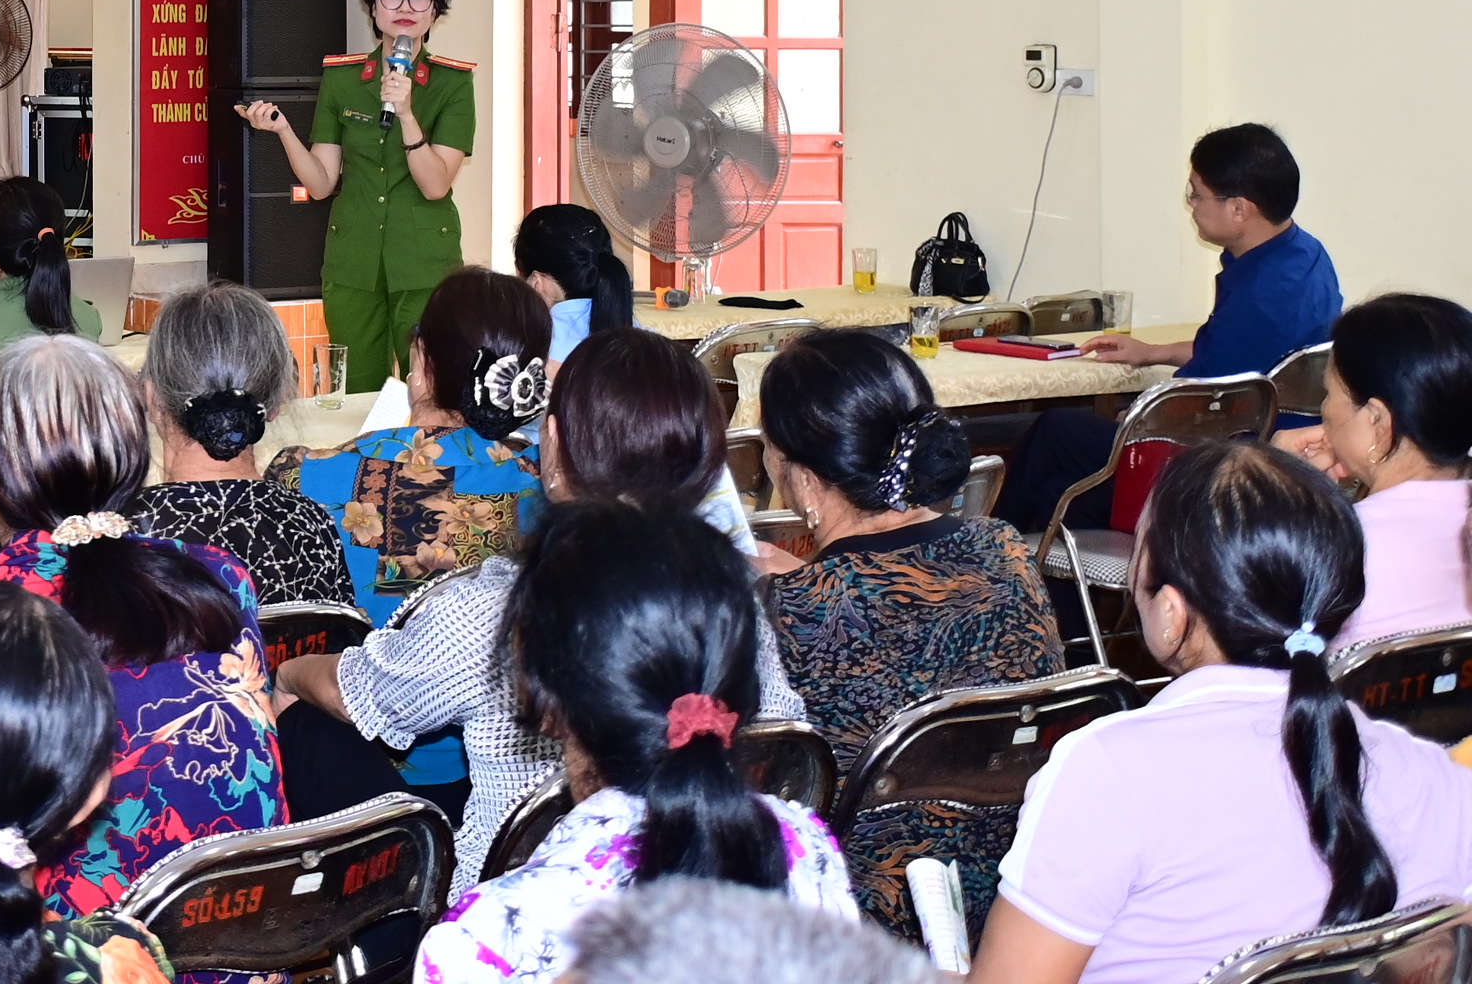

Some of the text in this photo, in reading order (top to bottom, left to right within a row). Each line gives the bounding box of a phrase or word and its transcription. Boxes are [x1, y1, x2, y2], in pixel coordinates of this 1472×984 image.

[152, 0, 187, 24] XỨNG
[152, 33, 186, 57] LÃNH
[187, 66, 204, 89] TỚ
[151, 99, 191, 123] THÀNH
